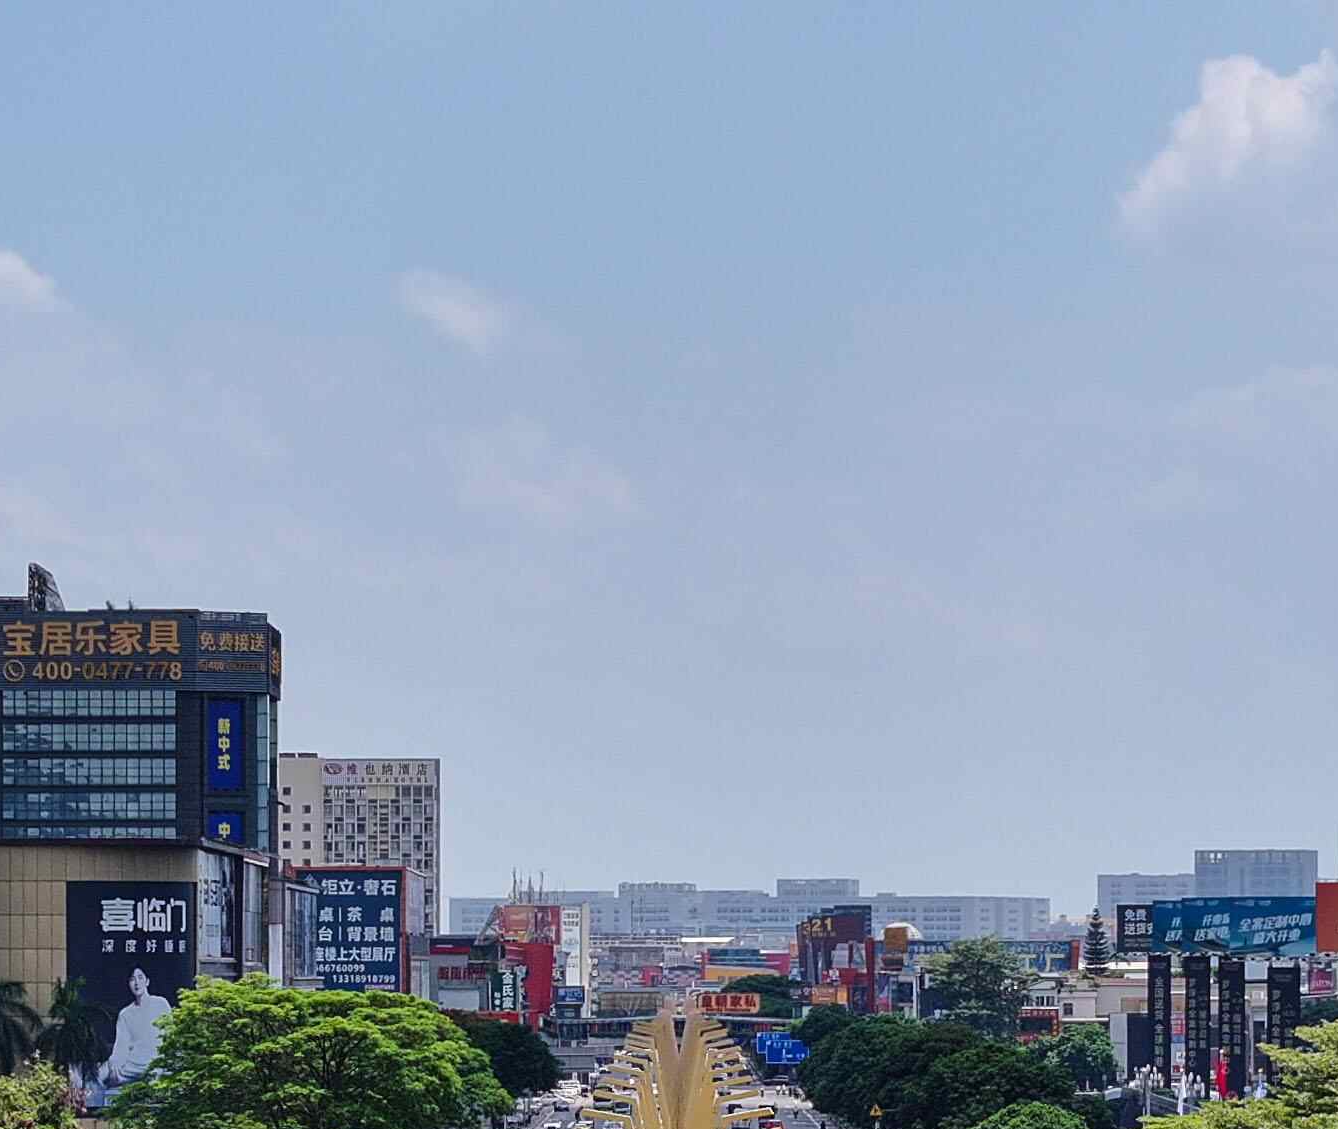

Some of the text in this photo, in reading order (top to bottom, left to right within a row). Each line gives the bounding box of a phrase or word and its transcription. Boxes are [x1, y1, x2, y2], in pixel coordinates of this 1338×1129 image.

[2, 620, 182, 656] 宝居乐家具
[199, 631, 265, 652] 免费接送
[32, 662, 182, 681] 400-0477-778
[346, 762, 429, 776] 维也纳酒店
[100, 897, 187, 933] 喜临门
